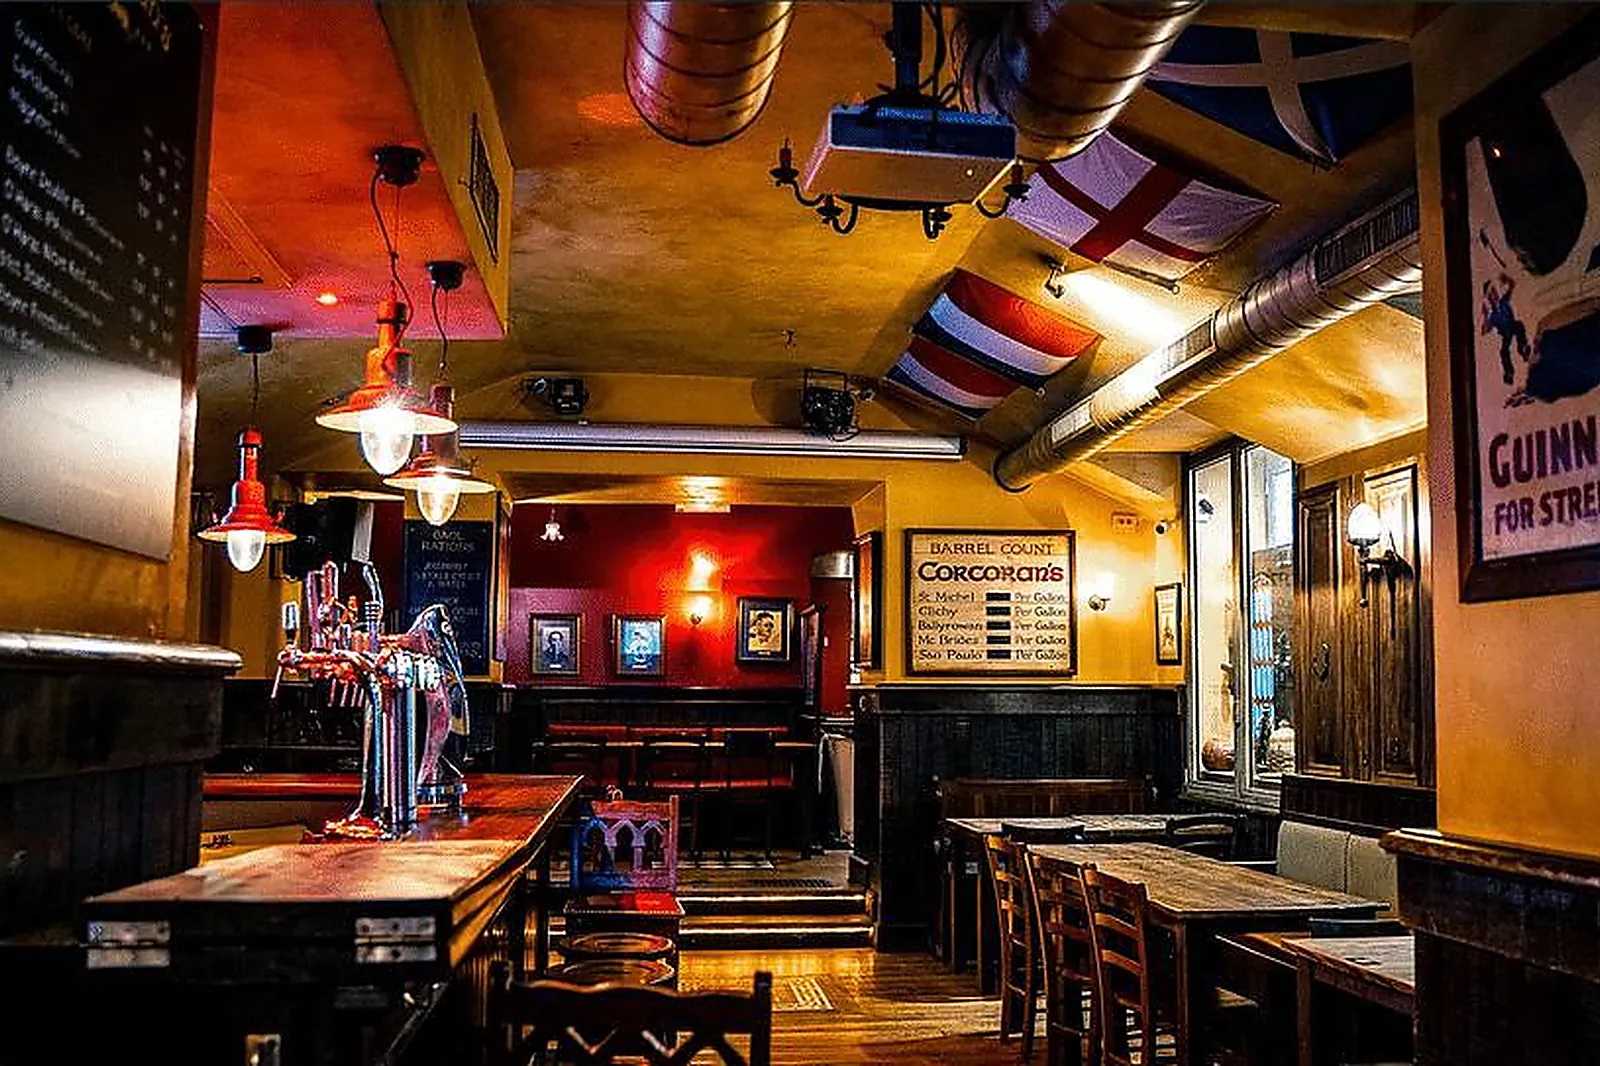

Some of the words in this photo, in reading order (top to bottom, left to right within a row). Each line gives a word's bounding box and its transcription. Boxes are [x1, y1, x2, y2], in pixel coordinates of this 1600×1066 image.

[1489, 415, 1597, 489] GUINN
[1494, 497, 1534, 536] FOR
[1540, 480, 1600, 527] STRE
[930, 543, 995, 555] BARREL
[1000, 543, 1053, 555] COUNT
[1033, 592, 1065, 604] Gallon
[1015, 606, 1033, 617] Per
[1034, 606, 1067, 617] Gallon
[1034, 620, 1067, 631] Gallon
[1035, 635, 1067, 645] Gallon
[947, 649, 983, 660] Paulo
[1016, 649, 1034, 660] Per
[1035, 649, 1068, 660] Gallon
